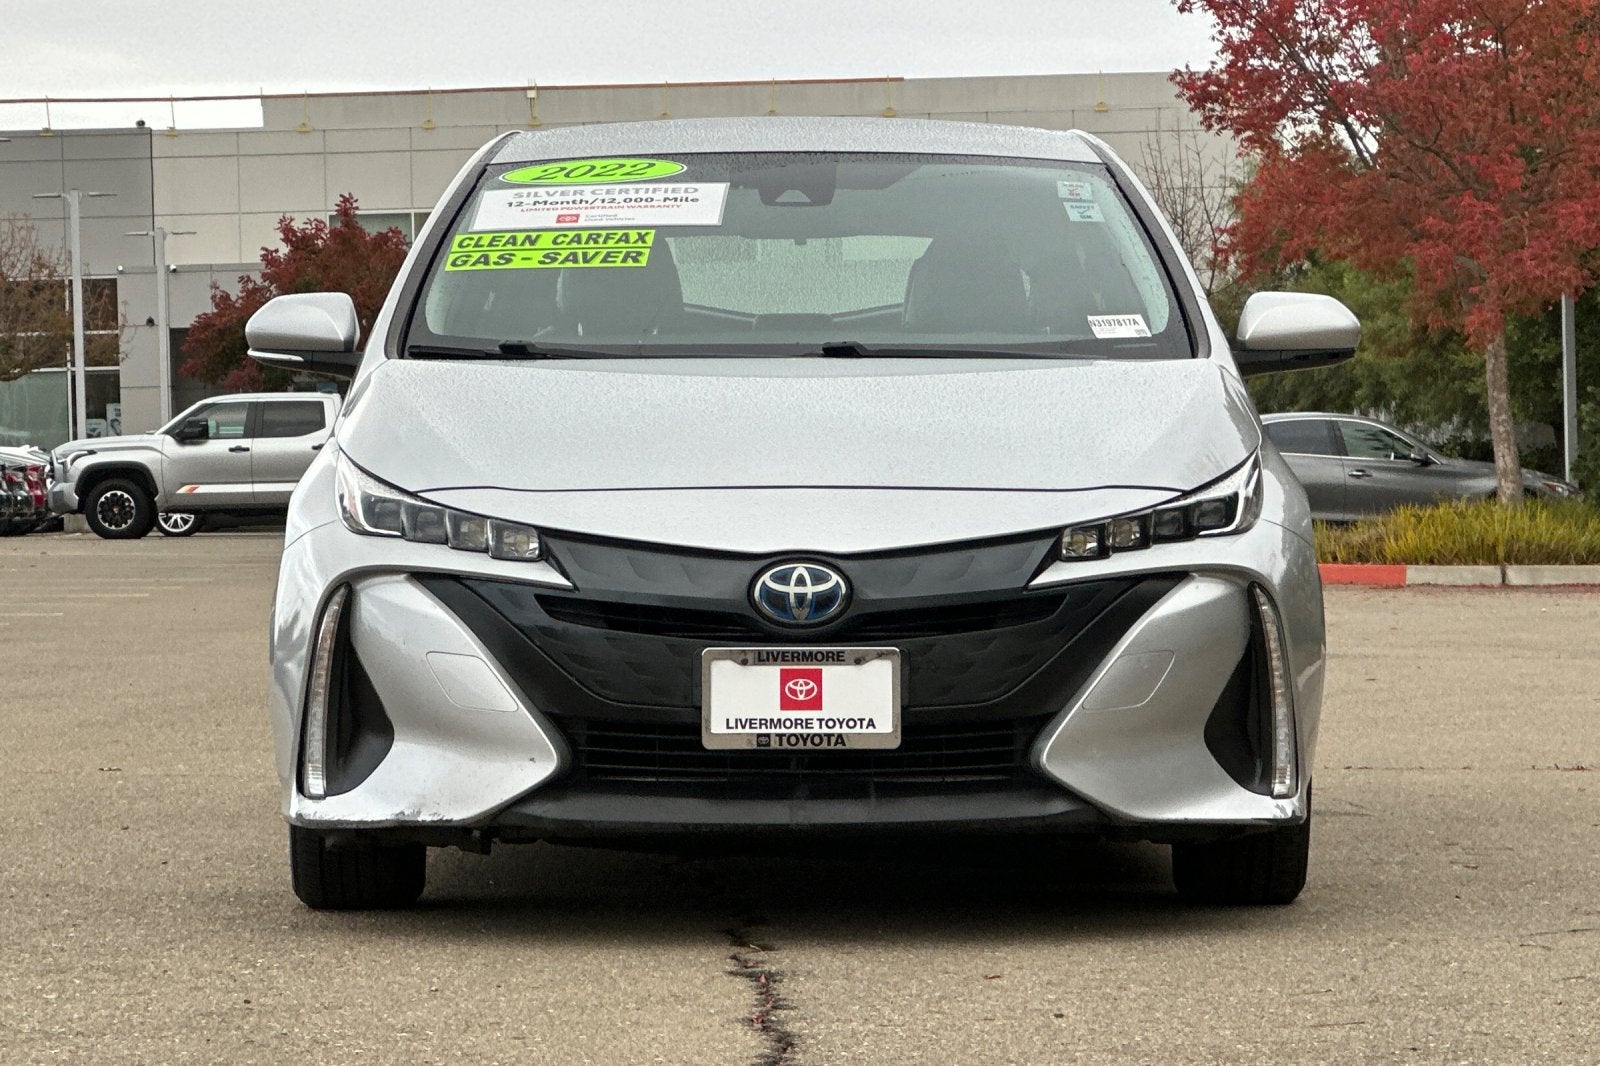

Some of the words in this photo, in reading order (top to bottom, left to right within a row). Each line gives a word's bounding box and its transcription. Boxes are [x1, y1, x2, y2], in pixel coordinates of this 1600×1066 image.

[530, 162, 657, 181] 2022
[513, 189, 586, 199] SILVER
[591, 186, 699, 196] CERTIFIED
[507, 196, 700, 208] 12-Month/12,000-Mile
[520, 205, 560, 213] LIMITED
[456, 233, 542, 250] CLEAN
[551, 231, 651, 246] CARFAX
[450, 252, 517, 267] GAS
[538, 250, 647, 265] SAVER
[757, 650, 845, 662] LIVERMORE
[726, 718, 814, 730] LIVERMORE
[816, 718, 876, 730] TOYOTA
[775, 733, 847, 747] TOYOTA
